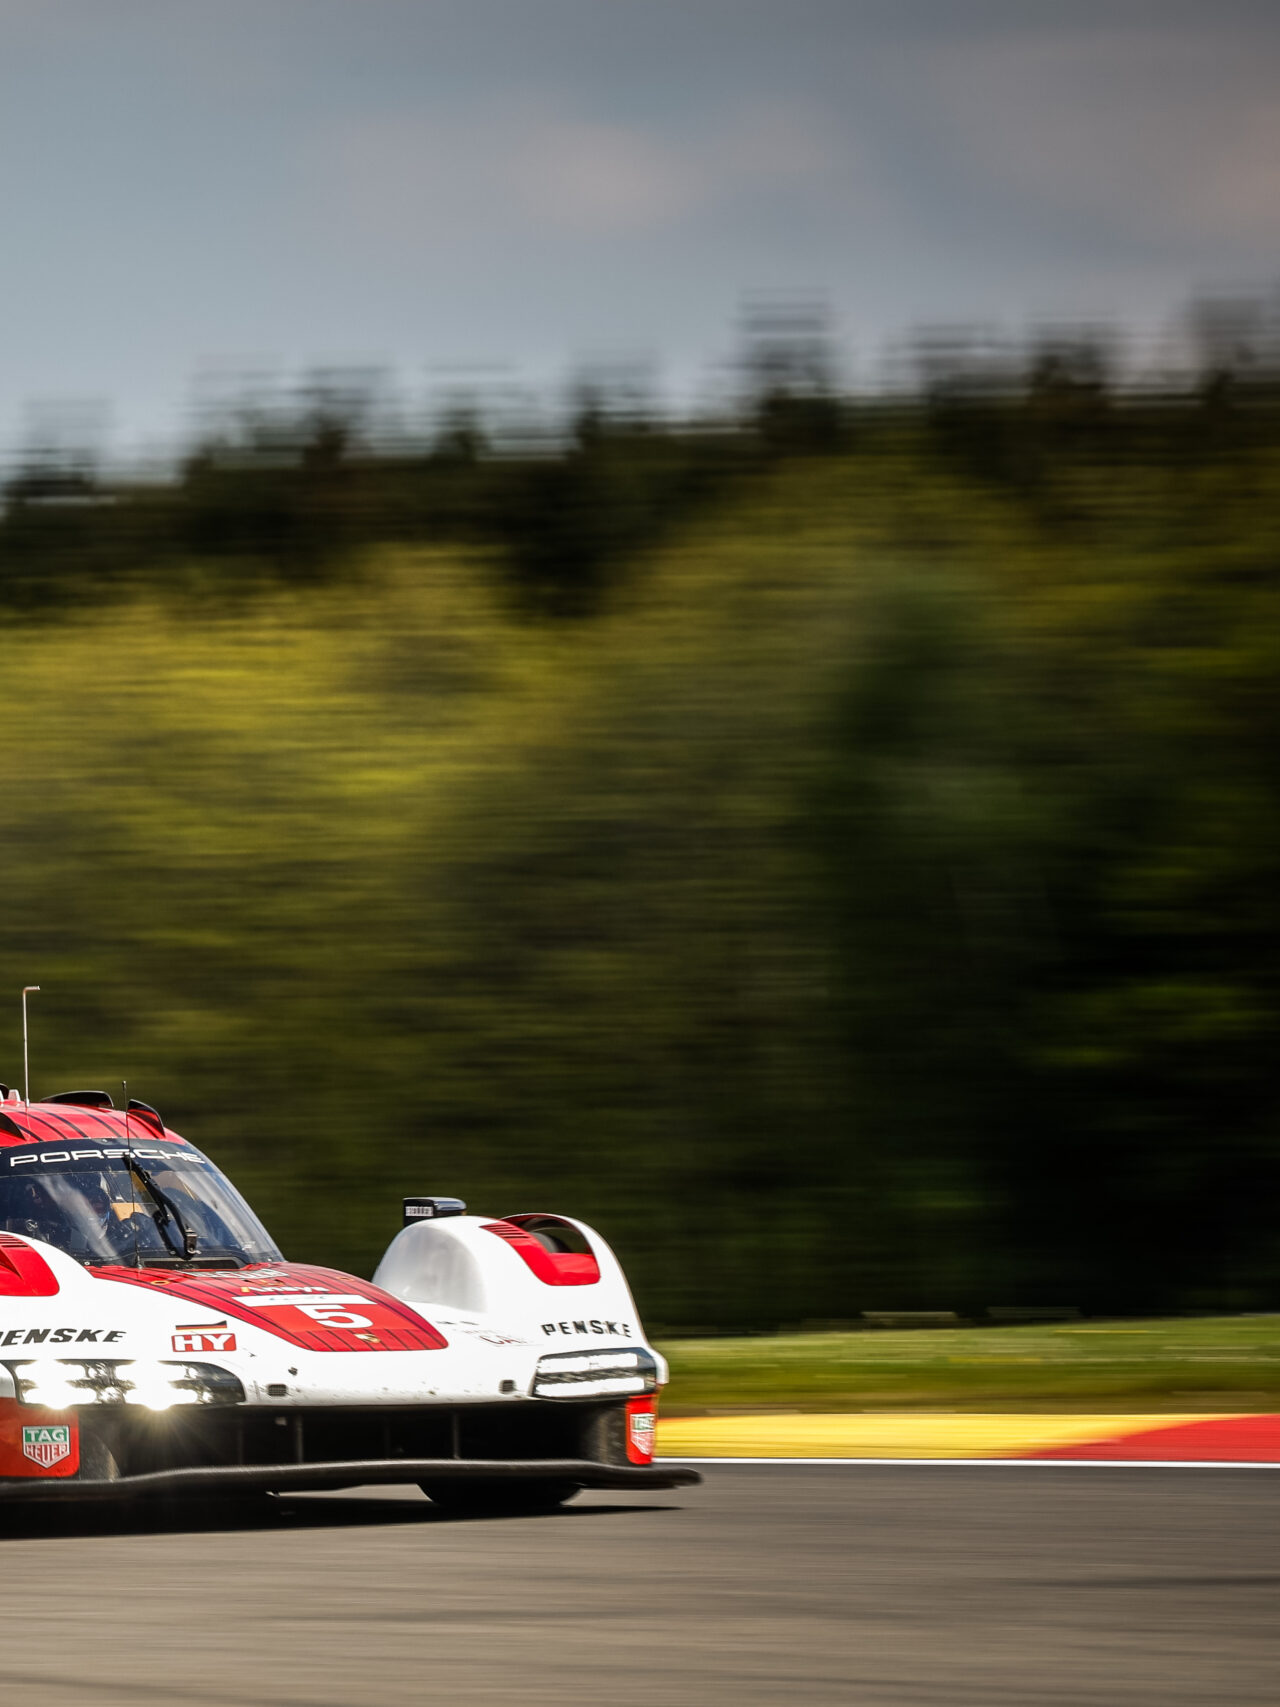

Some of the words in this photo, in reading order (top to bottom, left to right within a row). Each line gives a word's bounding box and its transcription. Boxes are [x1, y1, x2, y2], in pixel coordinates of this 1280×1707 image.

[10, 1148, 205, 1167] PORSCHE
[294, 1304, 374, 1328] 5
[540, 1320, 632, 1338] PENSKE
[174, 1334, 233, 1351] HY
[27, 1429, 65, 1442] TAG
[26, 1444, 67, 1464] HEUER
